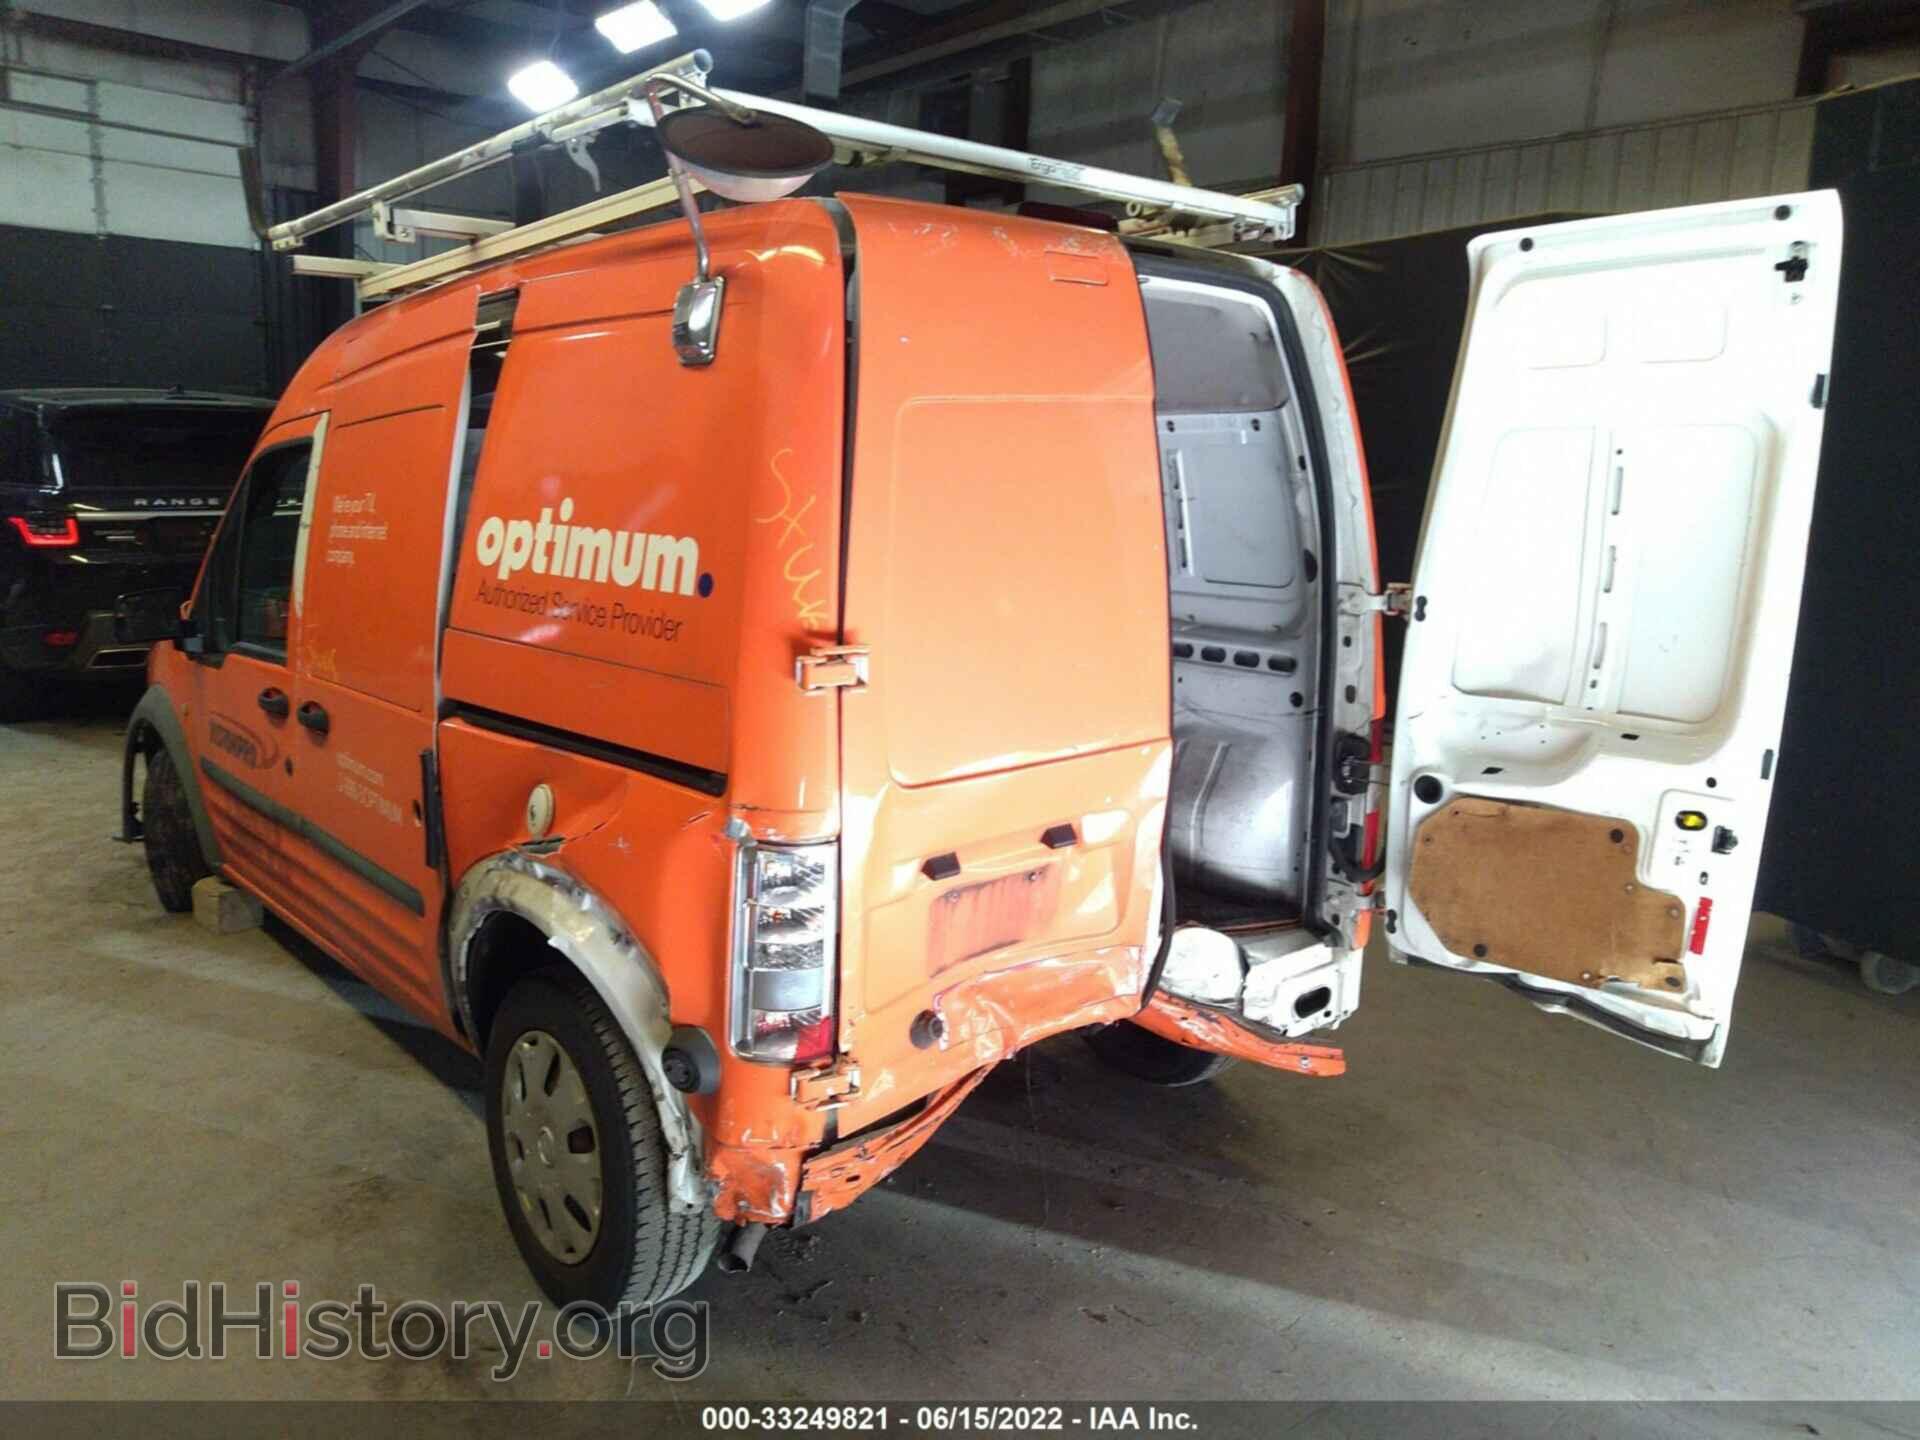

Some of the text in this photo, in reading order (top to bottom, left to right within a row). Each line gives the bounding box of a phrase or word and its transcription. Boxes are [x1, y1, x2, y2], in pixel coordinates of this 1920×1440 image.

[133, 497, 221, 507] RANGE
[475, 577, 685, 642] Authorized Service Provider
